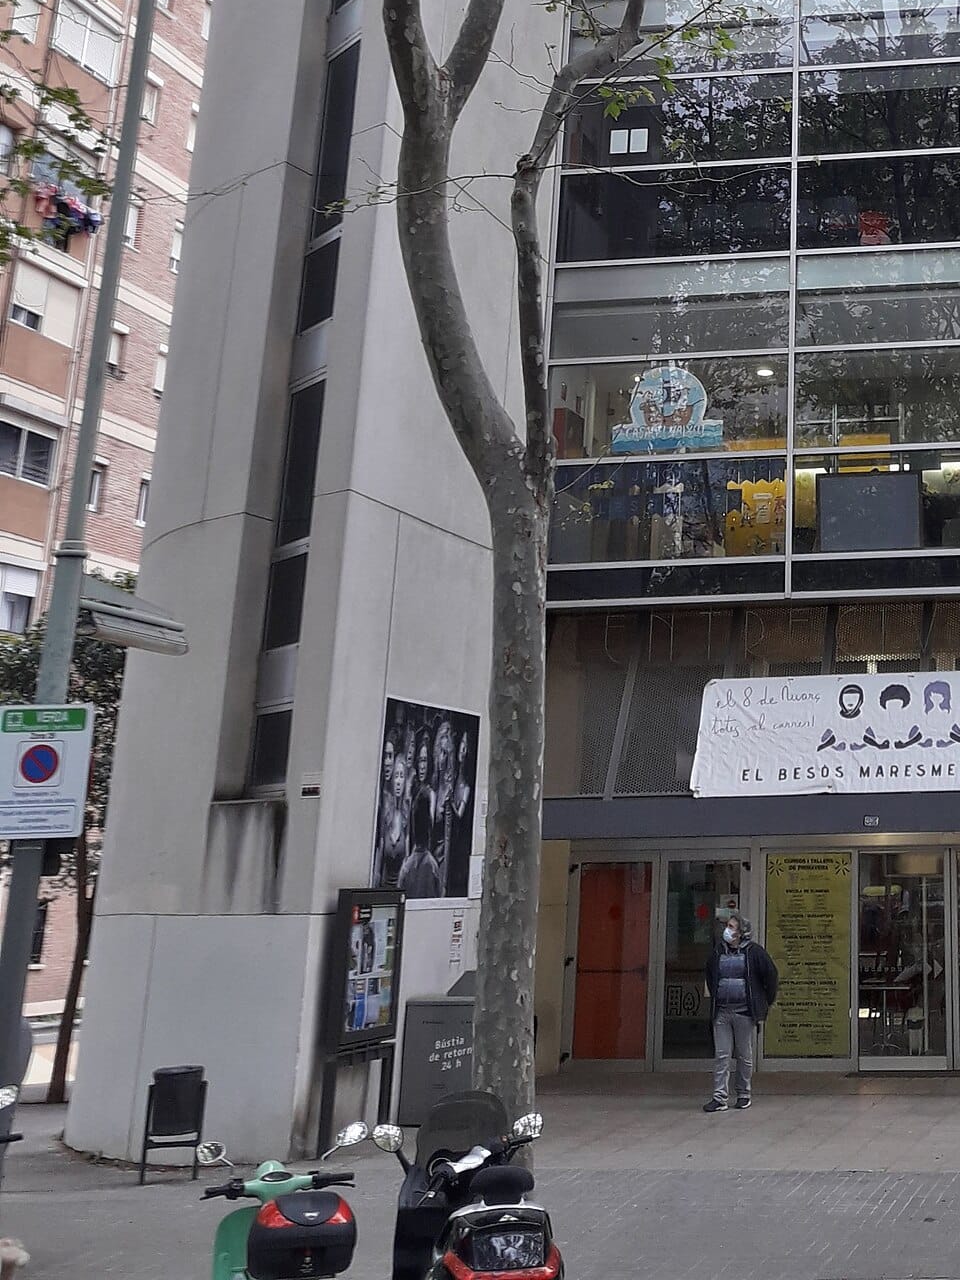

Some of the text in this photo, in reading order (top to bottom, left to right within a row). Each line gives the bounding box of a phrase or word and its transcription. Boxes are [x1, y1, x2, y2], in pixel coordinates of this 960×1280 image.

[742, 686, 753, 707] 8
[757, 685, 778, 705] de
[747, 713, 766, 730] al
[742, 768, 764, 781] EL
[778, 765, 844, 780] BESÒS
[859, 763, 956, 778] MARESME
[435, 1036, 465, 1050] Bústia
[428, 1046, 473, 1063] de retorn
[441, 1058, 462, 1071] 24 h
